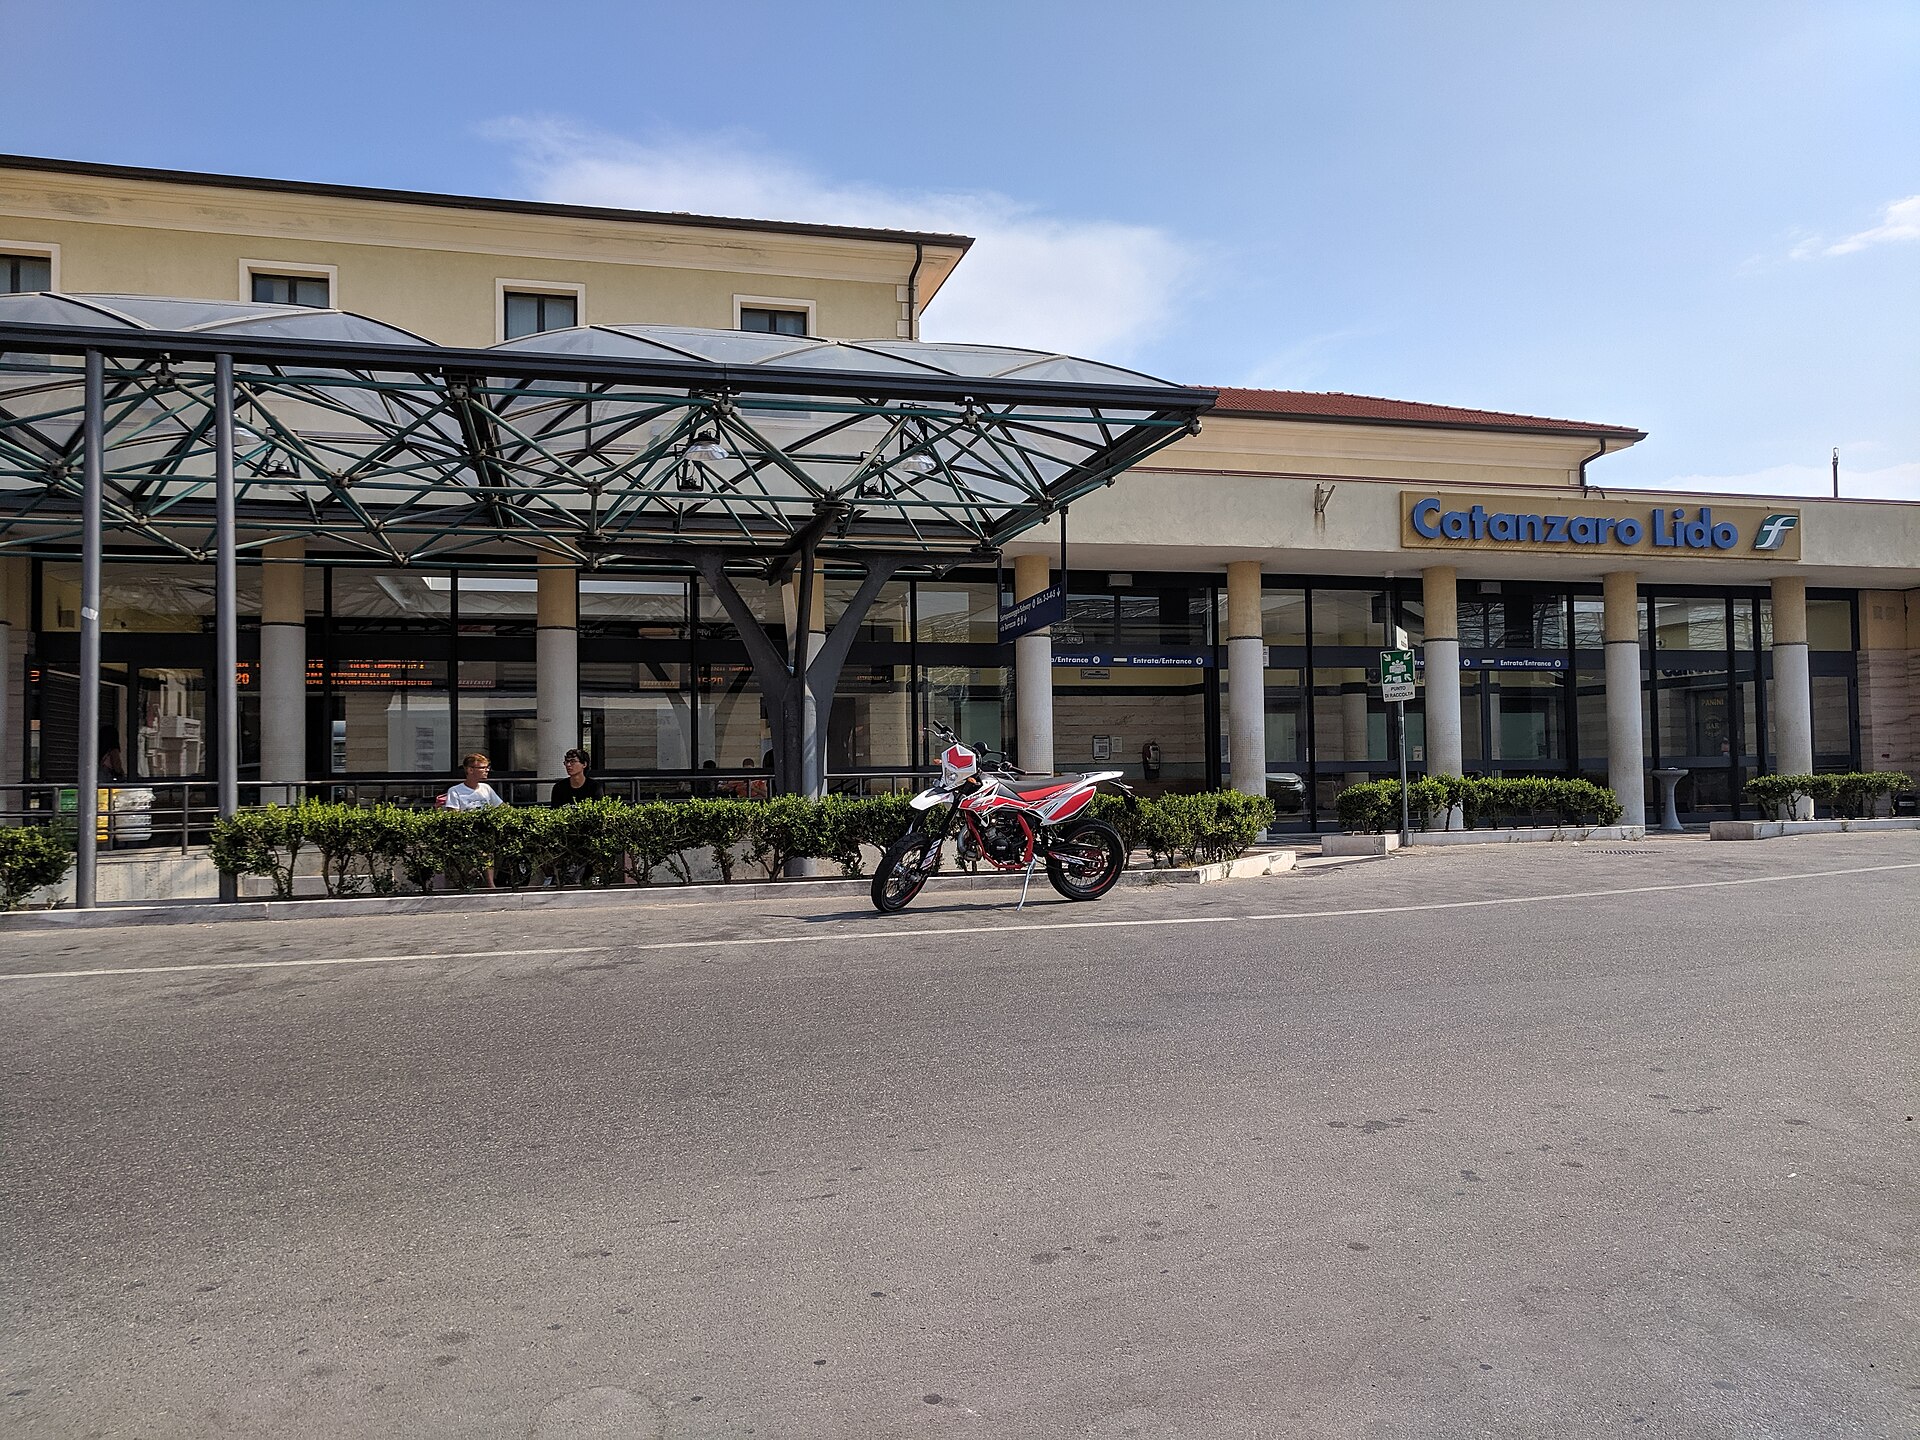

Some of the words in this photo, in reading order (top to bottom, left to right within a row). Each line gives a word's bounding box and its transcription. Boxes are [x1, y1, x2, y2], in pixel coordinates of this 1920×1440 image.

[1412, 497, 1643, 546] Catanzaro
[1652, 507, 1739, 550] Lido
[1051, 656, 1089, 664] a/Entrance
[1133, 657, 1192, 665] Entrata/Entrance
[1500, 659, 1551, 667] Entrata/Entrance
[1701, 698, 1724, 706] PANINI
